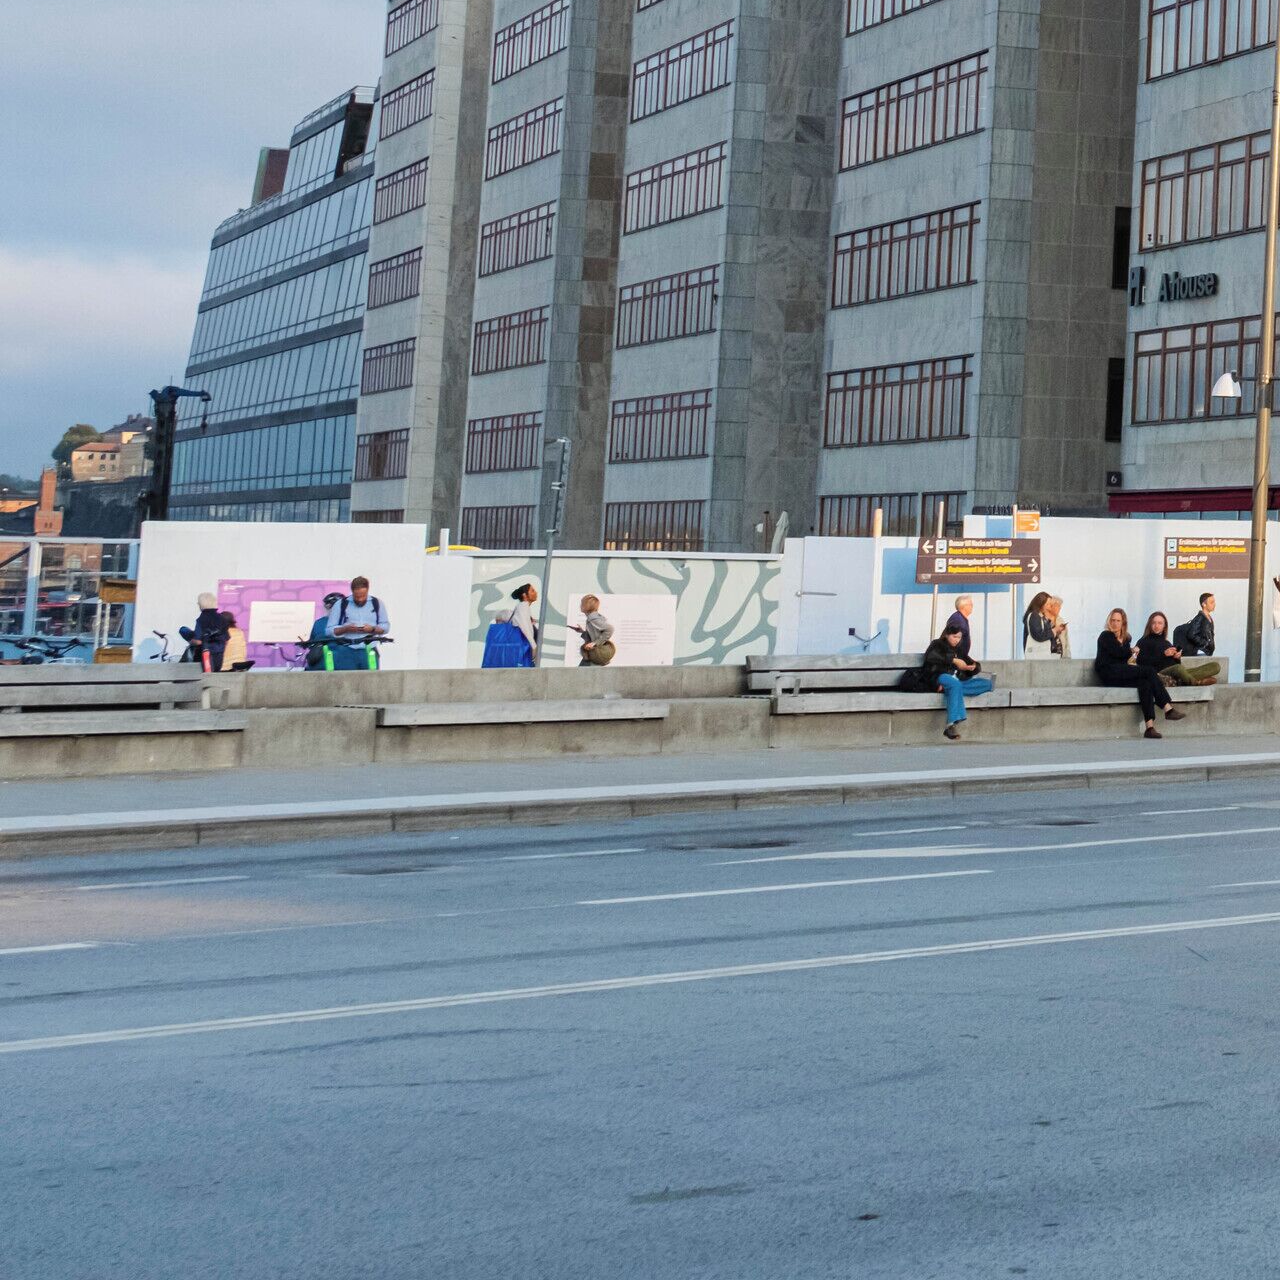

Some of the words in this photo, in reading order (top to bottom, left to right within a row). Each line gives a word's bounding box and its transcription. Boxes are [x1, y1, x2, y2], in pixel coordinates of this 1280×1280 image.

[1159, 273, 1170, 302] A
[1170, 271, 1219, 300] house
[1110, 474, 1118, 484] 6
